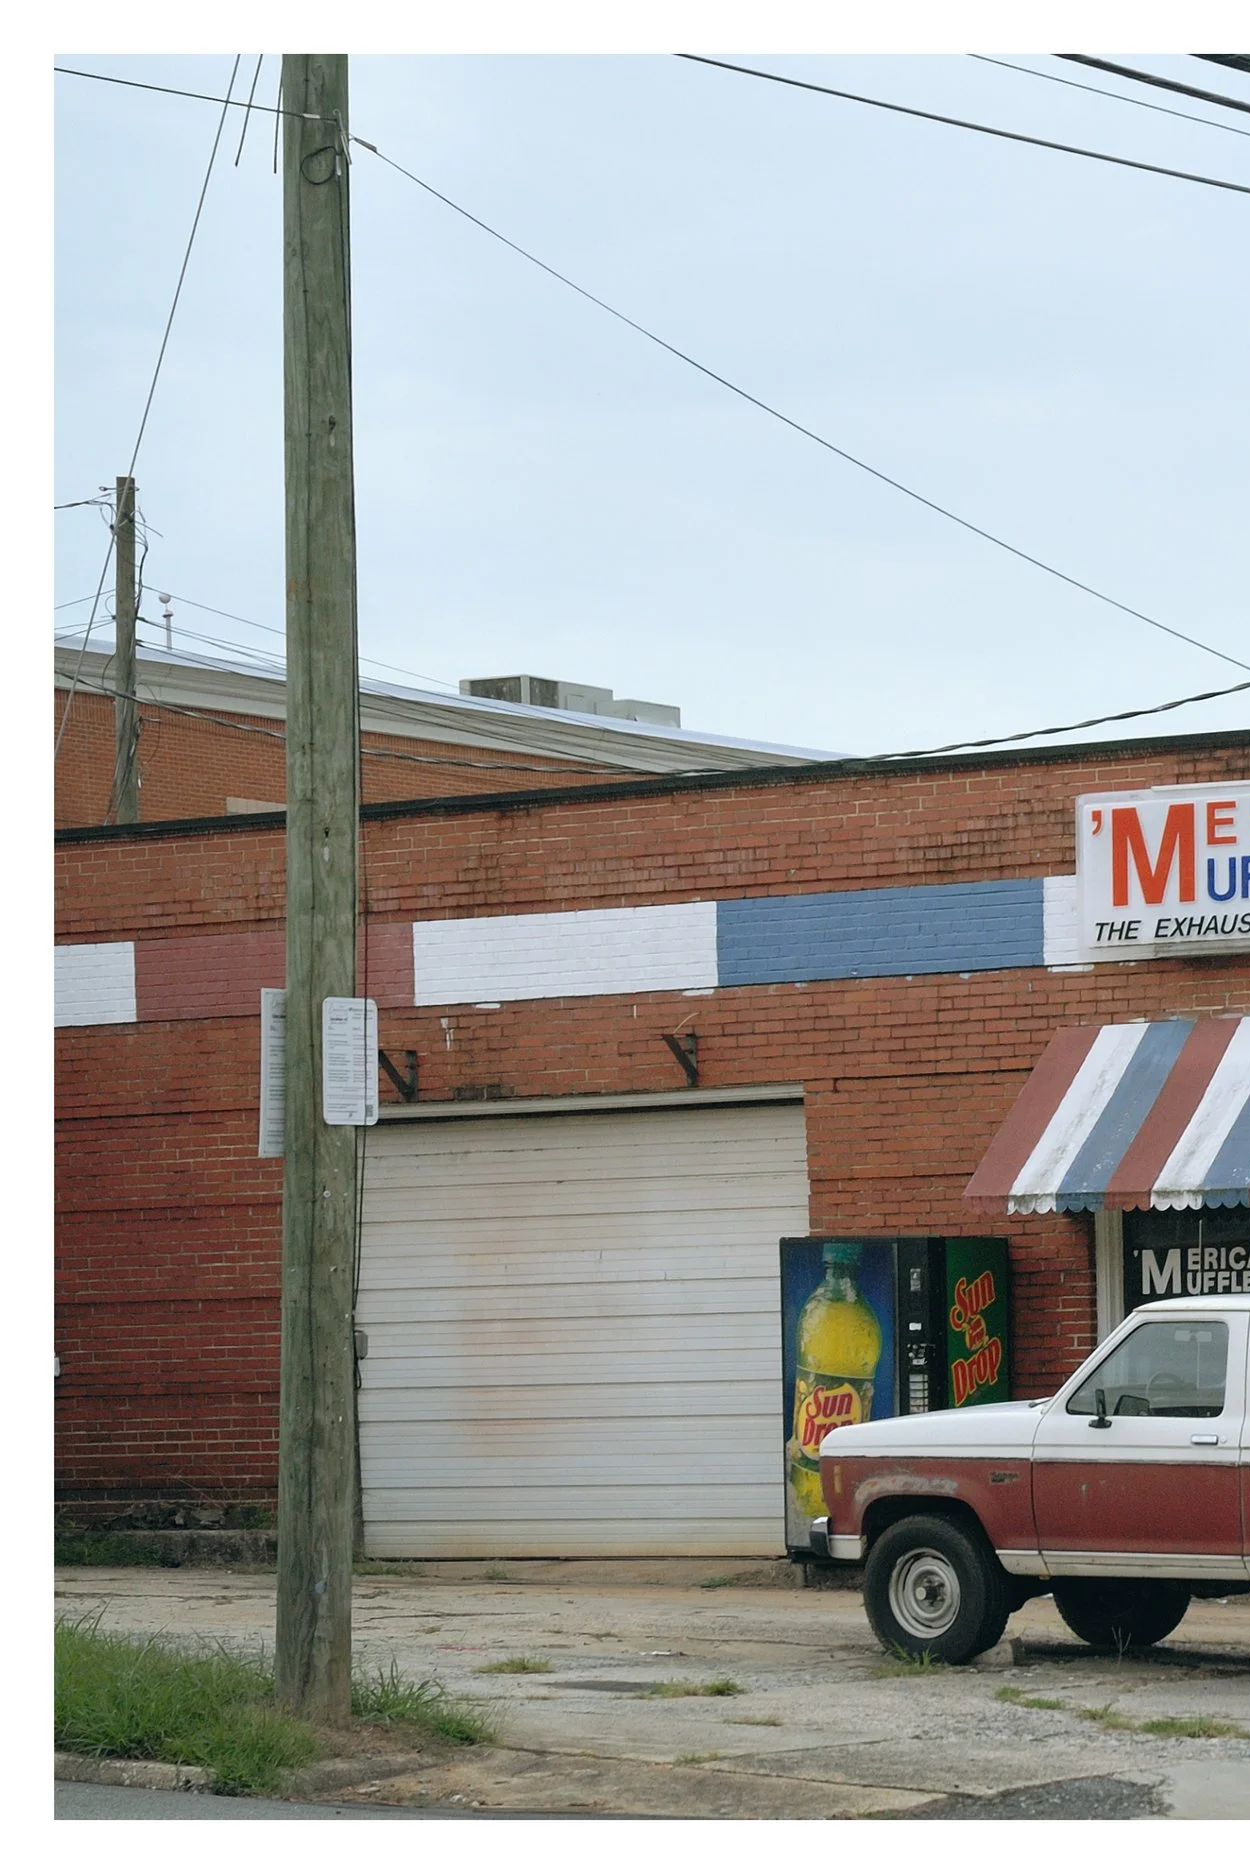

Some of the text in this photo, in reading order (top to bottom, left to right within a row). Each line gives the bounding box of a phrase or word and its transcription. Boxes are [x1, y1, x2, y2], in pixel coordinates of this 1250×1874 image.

[1095, 920, 1141, 942] THE
[950, 1271, 996, 1331] Sun
[952, 1337, 1001, 1407] Drop
[806, 1385, 853, 1419] Sun
[802, 1418, 853, 1446] Dro
